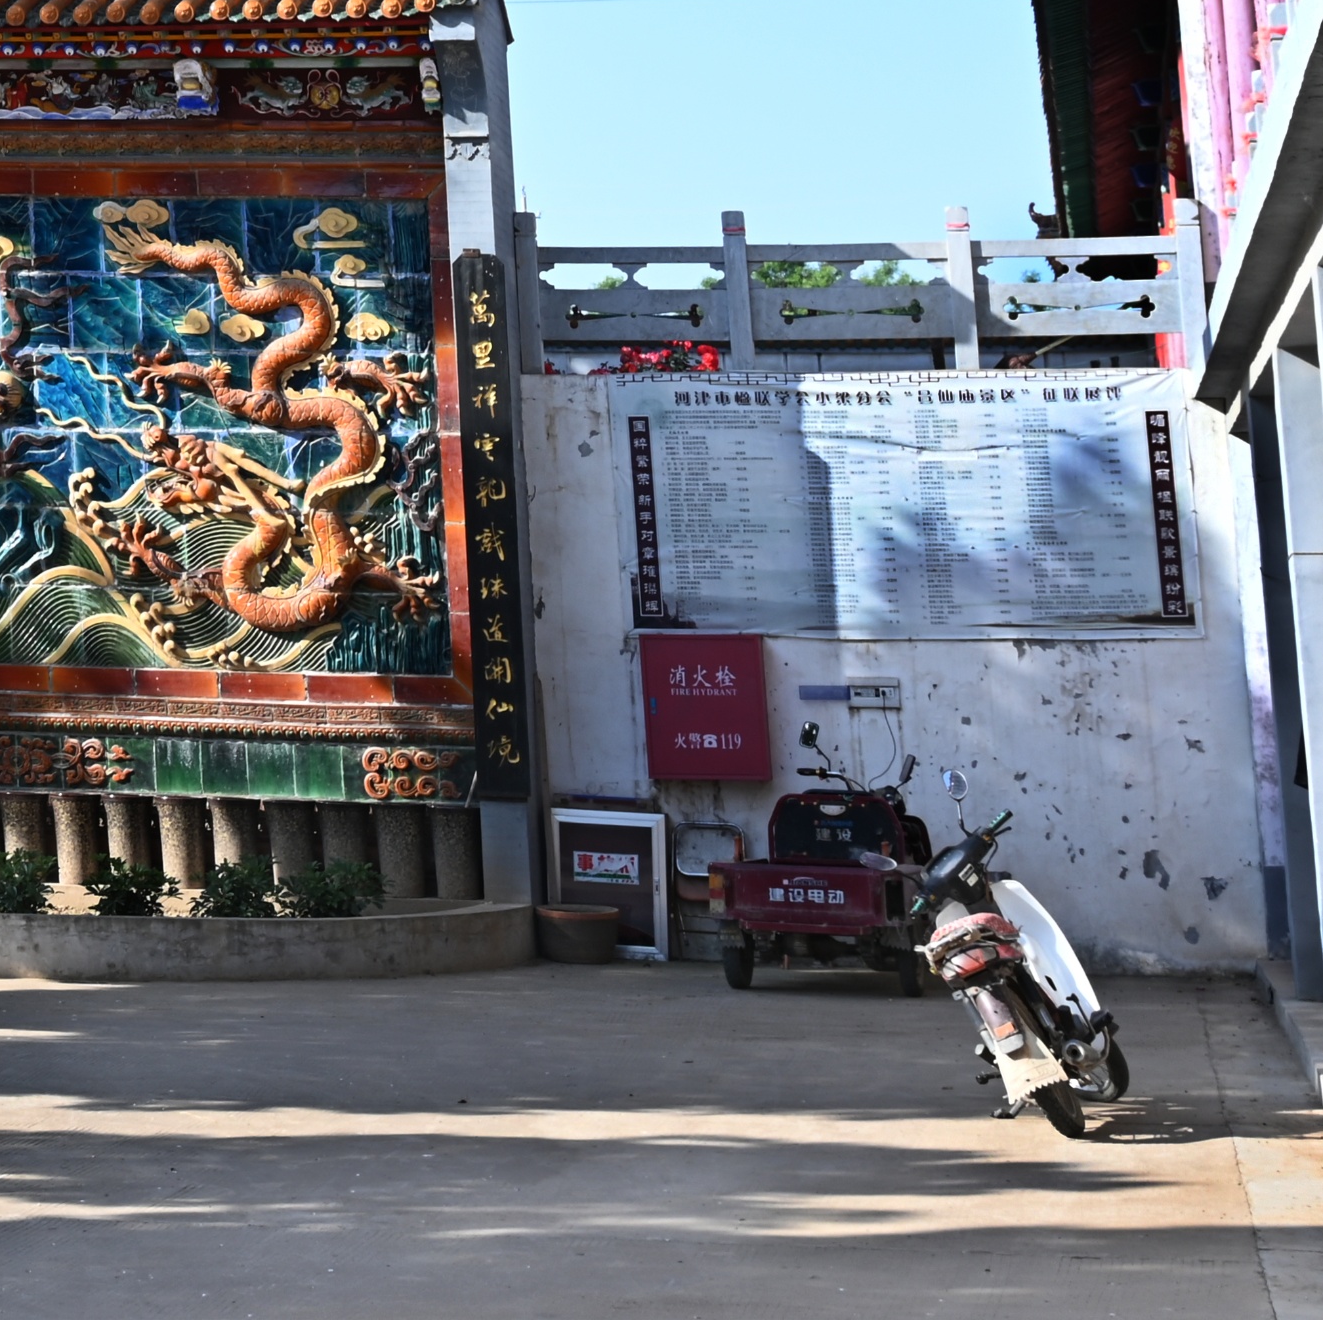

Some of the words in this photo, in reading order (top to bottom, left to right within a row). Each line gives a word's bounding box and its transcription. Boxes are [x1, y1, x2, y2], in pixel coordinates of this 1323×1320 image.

[669, 665, 736, 687] 消火栓
[671, 688, 690, 696] FIRE
[692, 688, 737, 696] HYDRANT
[674, 733, 702, 749] 火警
[720, 733, 742, 749] 119
[815, 828, 852, 842] 建设
[769, 887, 845, 904] 建设电动
